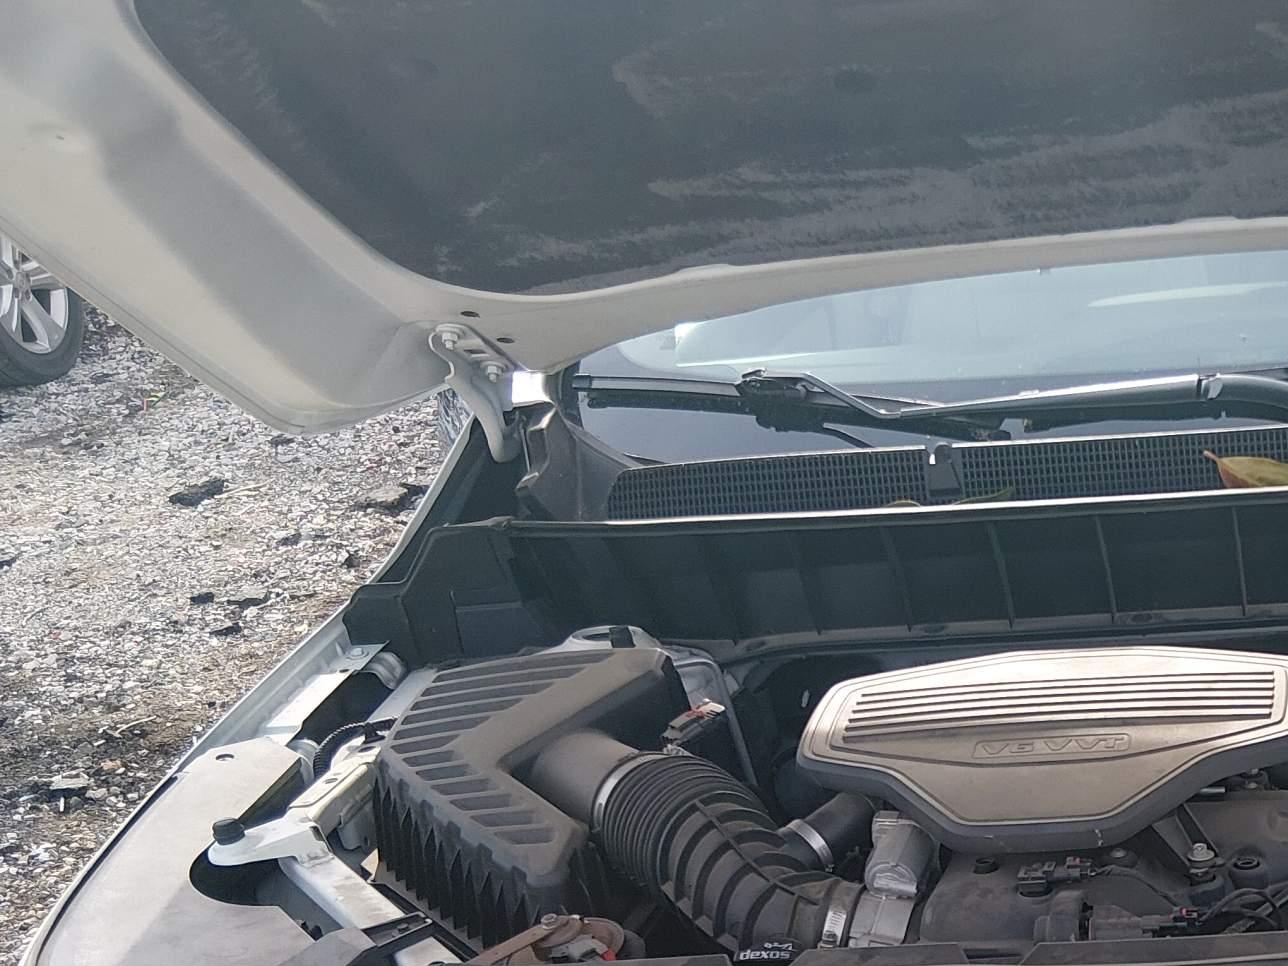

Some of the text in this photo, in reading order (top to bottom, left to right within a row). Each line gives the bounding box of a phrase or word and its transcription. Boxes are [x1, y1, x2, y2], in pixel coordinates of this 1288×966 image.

[982, 737, 1125, 755] V6 VVT
[739, 949, 791, 960] dexos
